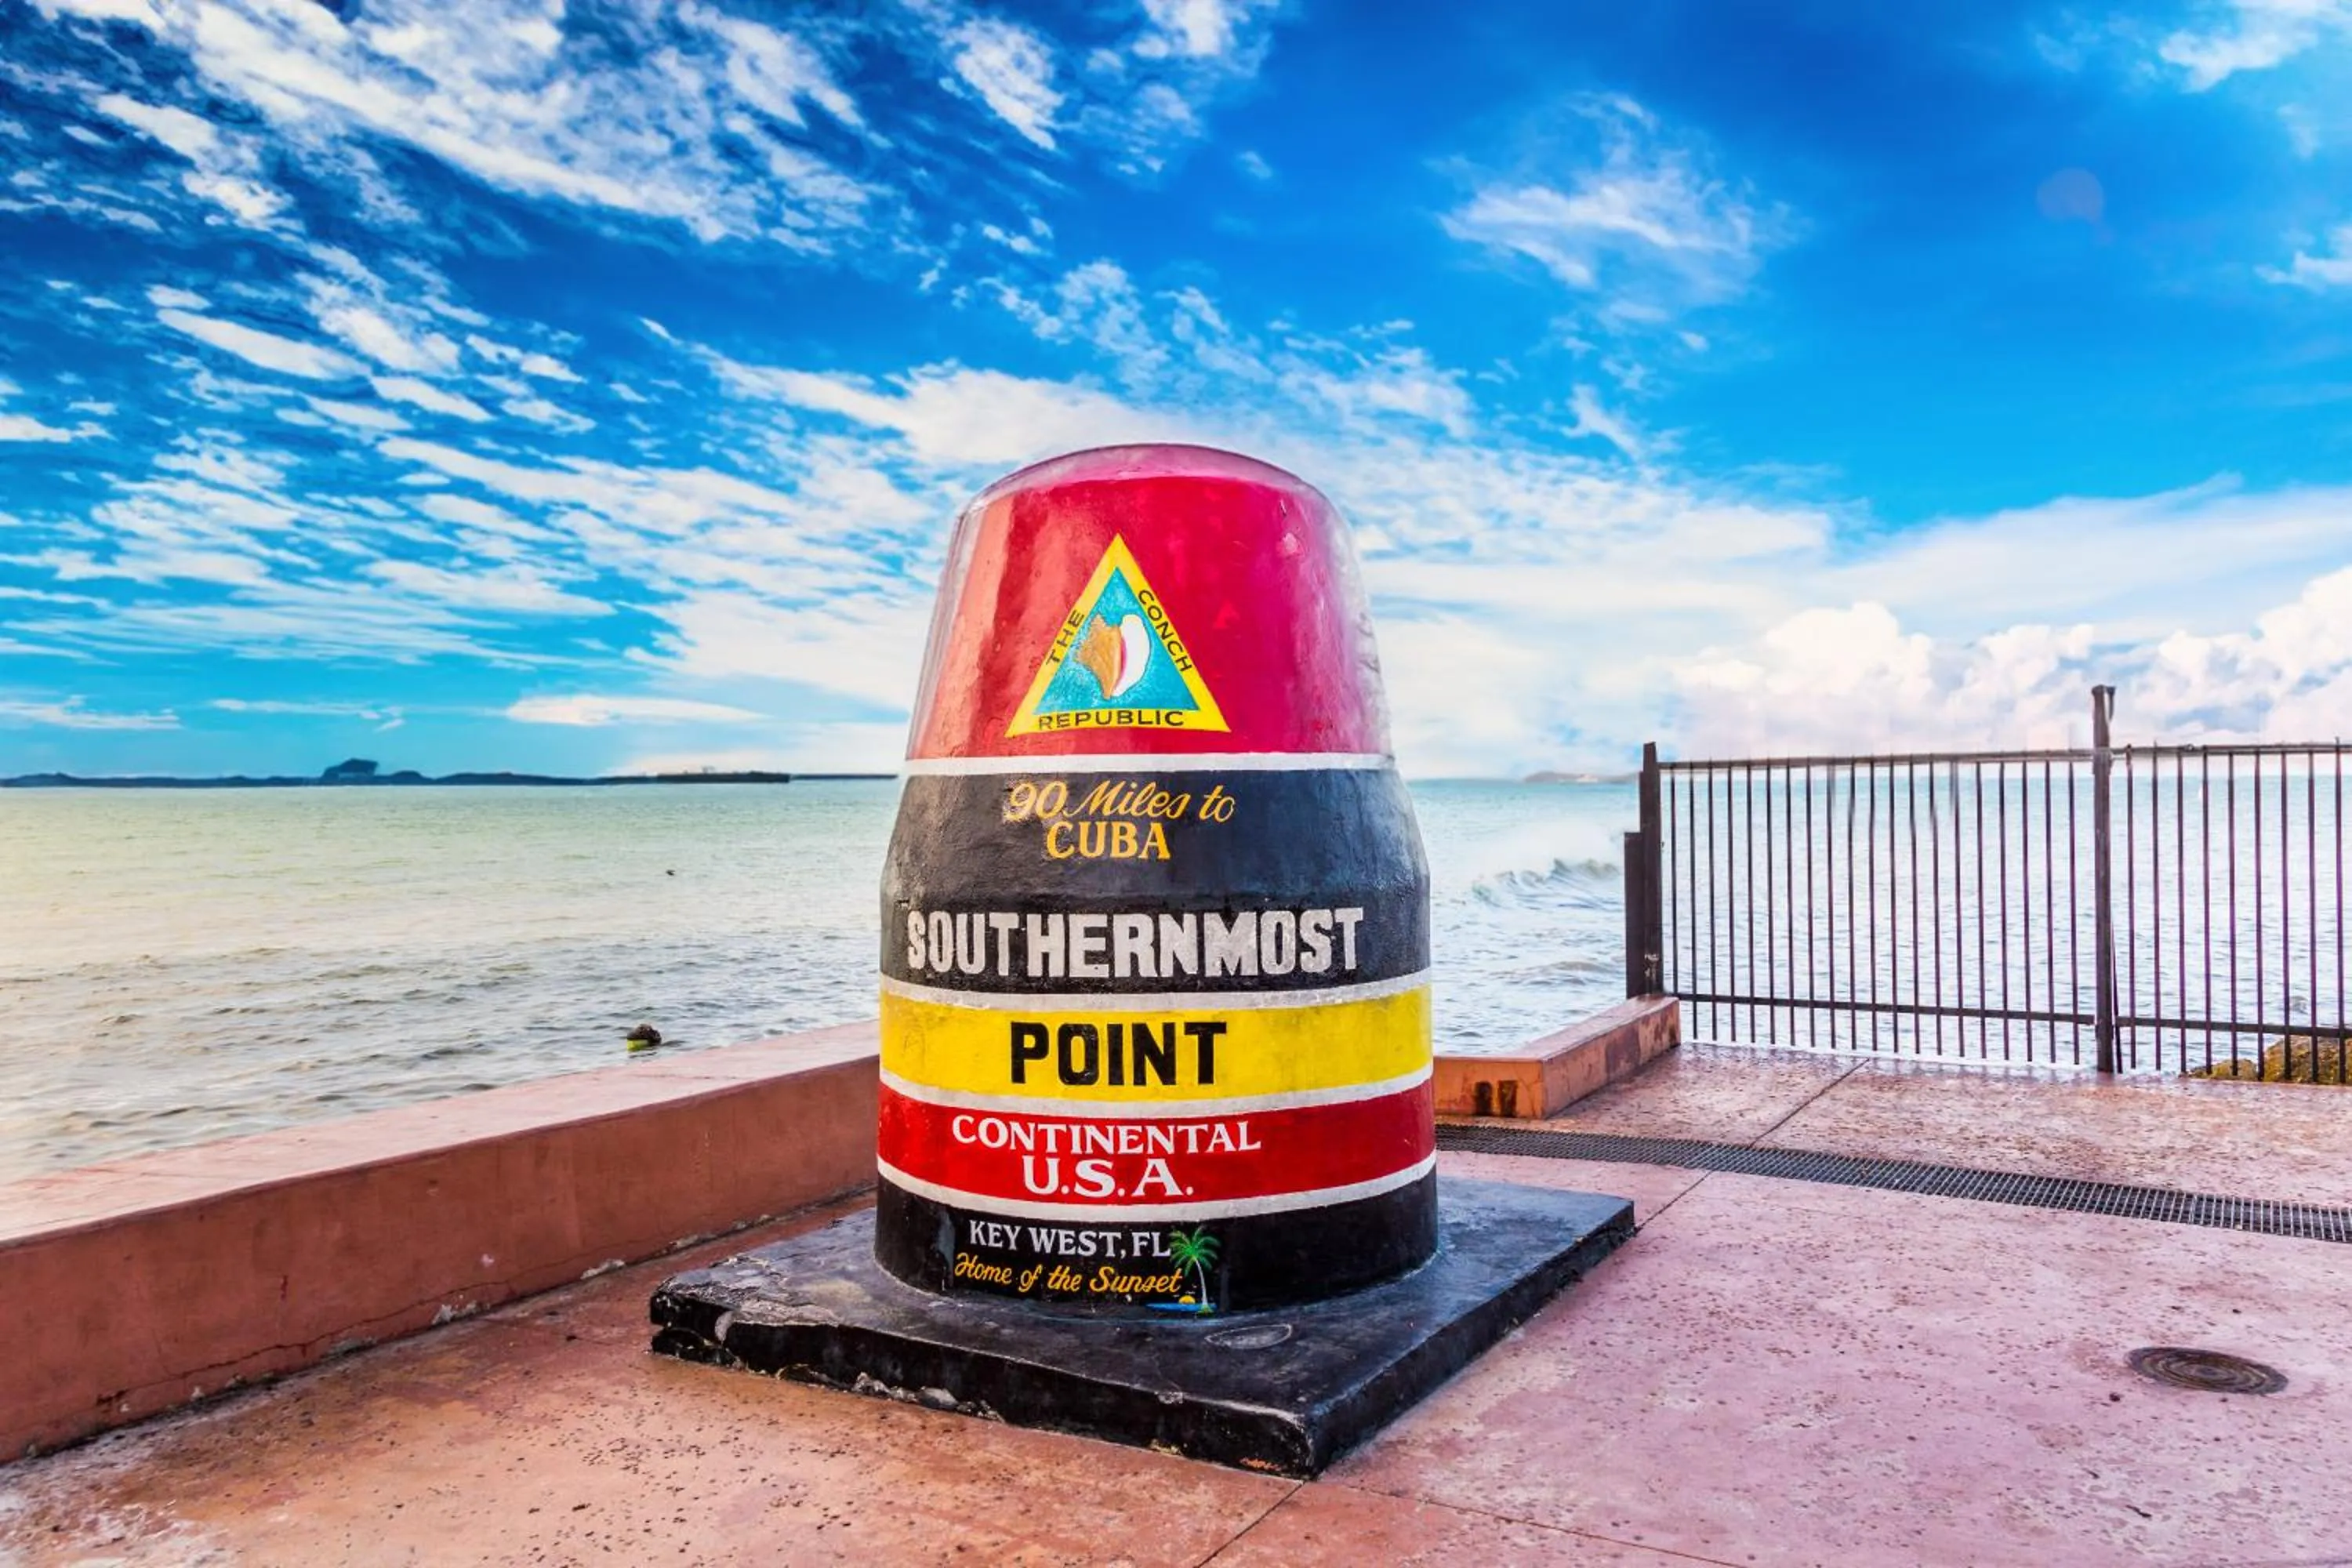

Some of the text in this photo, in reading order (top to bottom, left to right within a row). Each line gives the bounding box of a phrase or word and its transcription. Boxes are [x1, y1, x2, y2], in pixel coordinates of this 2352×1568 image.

[1047, 610, 1085, 666] THE
[1138, 590, 1192, 672] CONCH
[1039, 710, 1185, 730] REPUBLIC
[1007, 780, 1235, 822] 90 Miles to
[1046, 821, 1171, 861] CUBA
[906, 907, 1364, 978] SOUTHERNMOST
[1010, 1022, 1226, 1087] POINT
[952, 1115, 1261, 1155] CONTINENTAL
[1023, 1157, 1193, 1197] U.S.A.
[969, 1220, 1171, 1259] KEY WEST, FL
[954, 1254, 1183, 1294] Home of the Sunset
